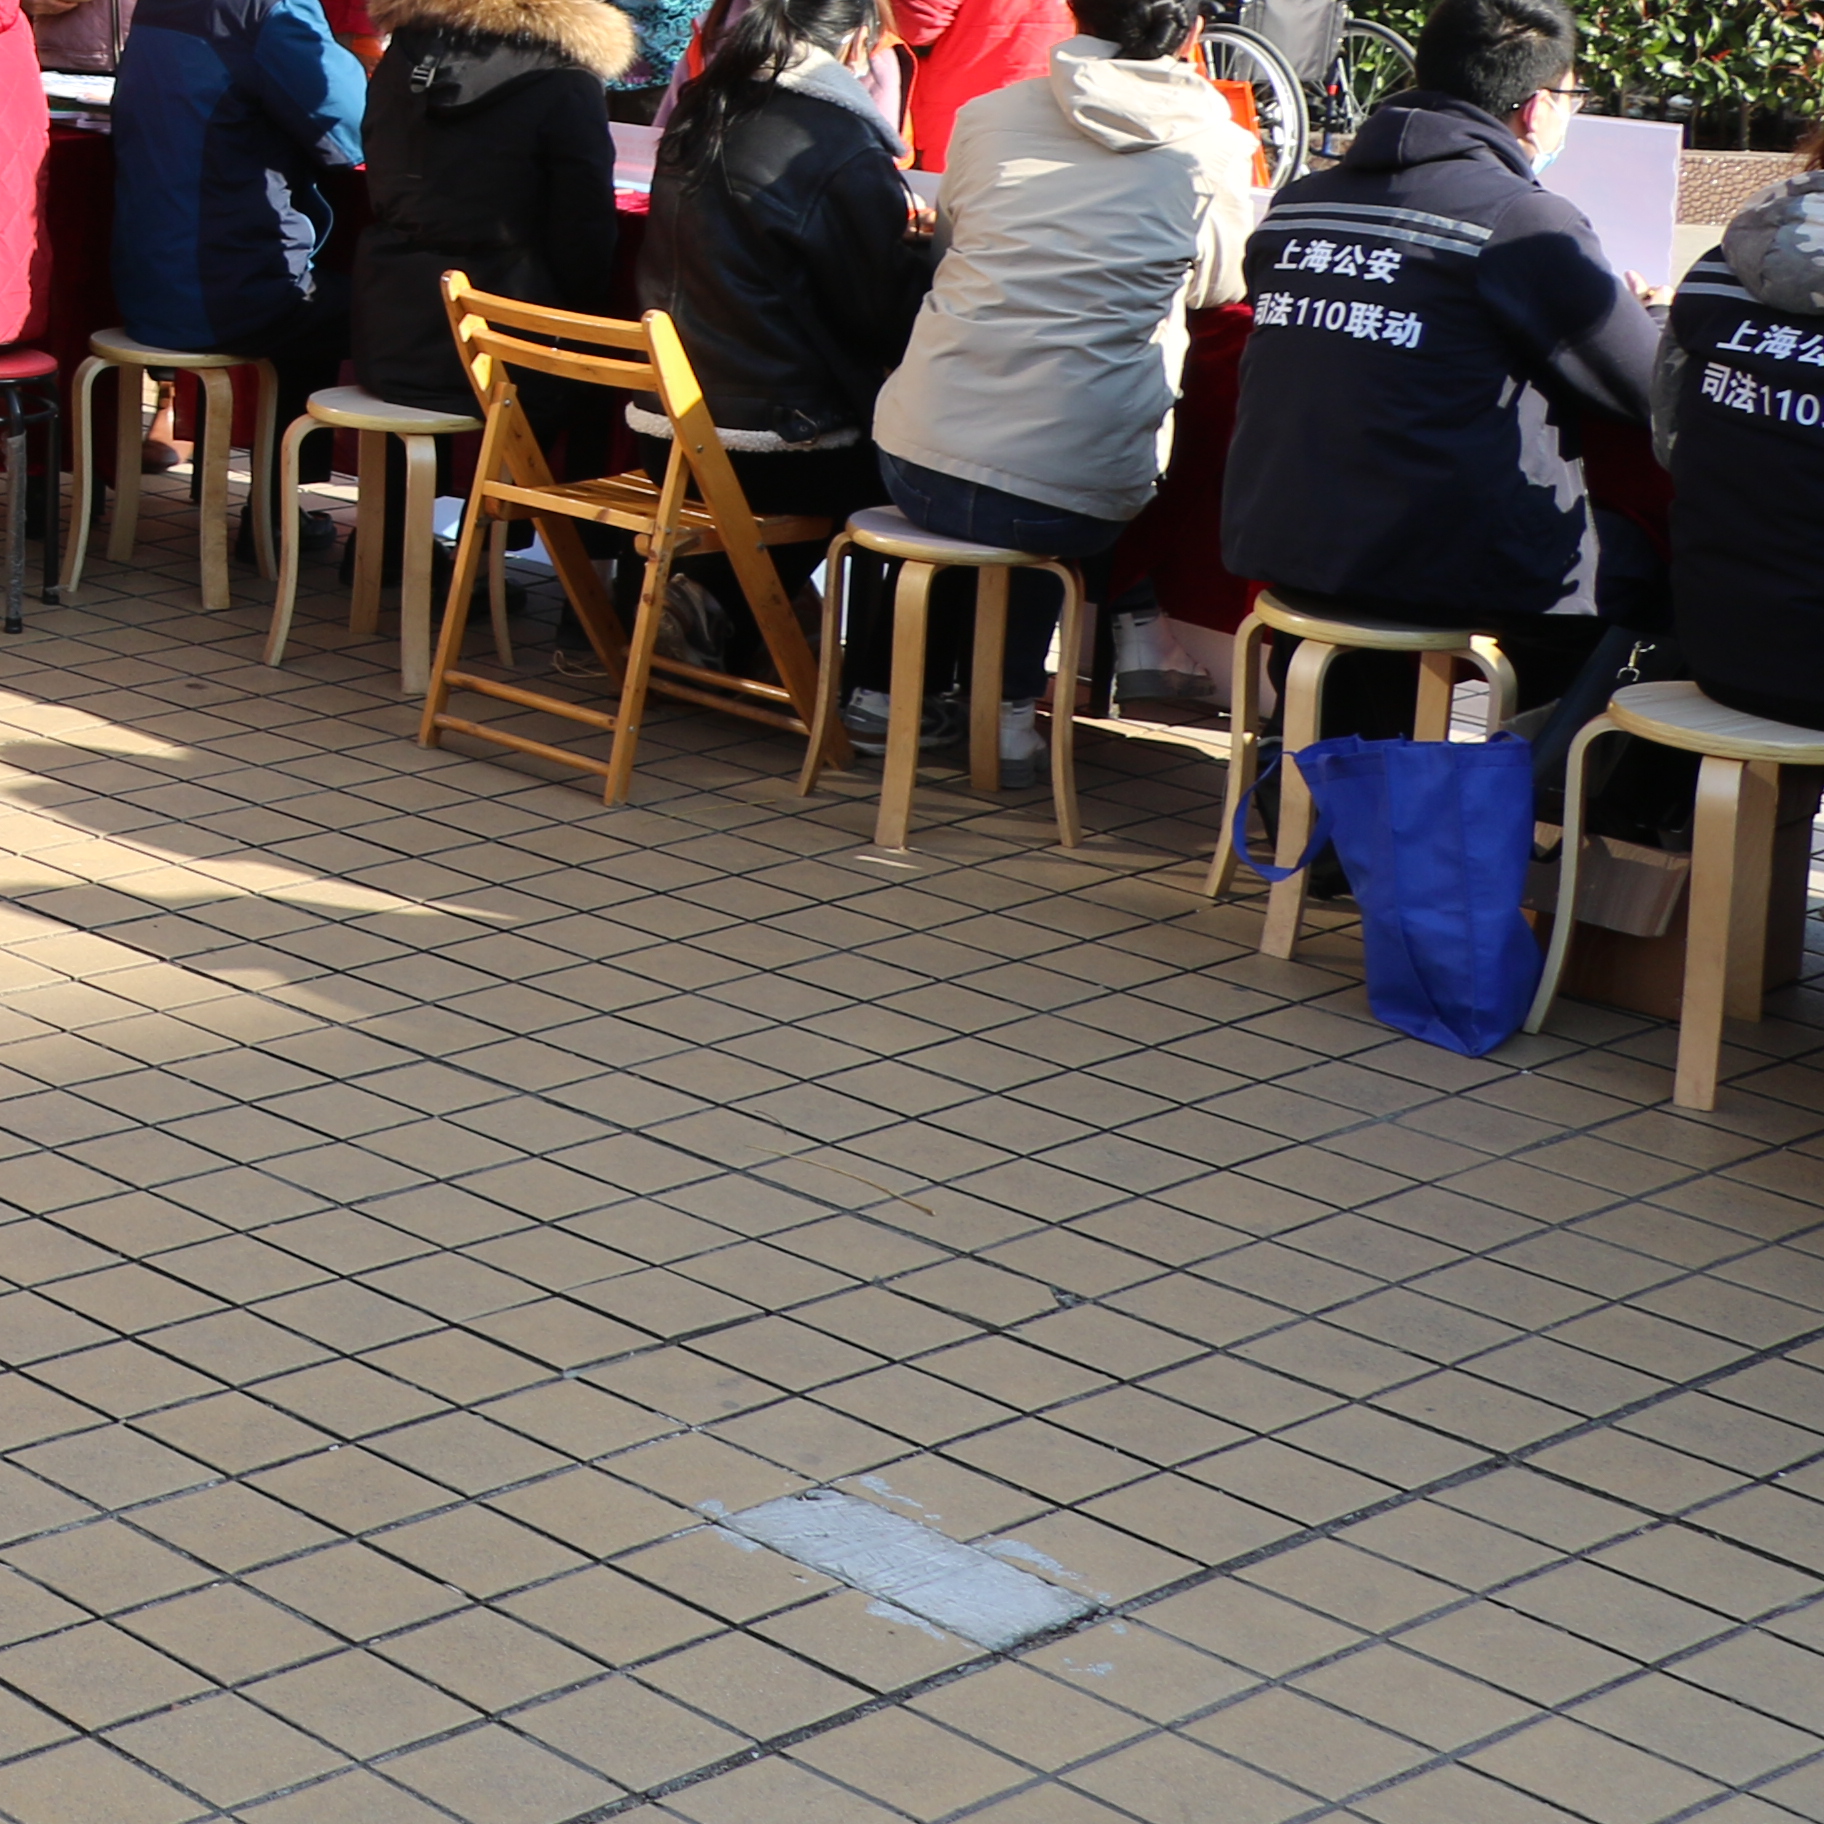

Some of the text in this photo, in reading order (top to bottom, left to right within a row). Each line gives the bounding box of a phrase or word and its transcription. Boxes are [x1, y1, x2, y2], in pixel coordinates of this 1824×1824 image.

[1273, 238, 1402, 284] 上海公安
[1253, 291, 1423, 349] 司法110联动
[1701, 361, 1824, 428] 司法110
